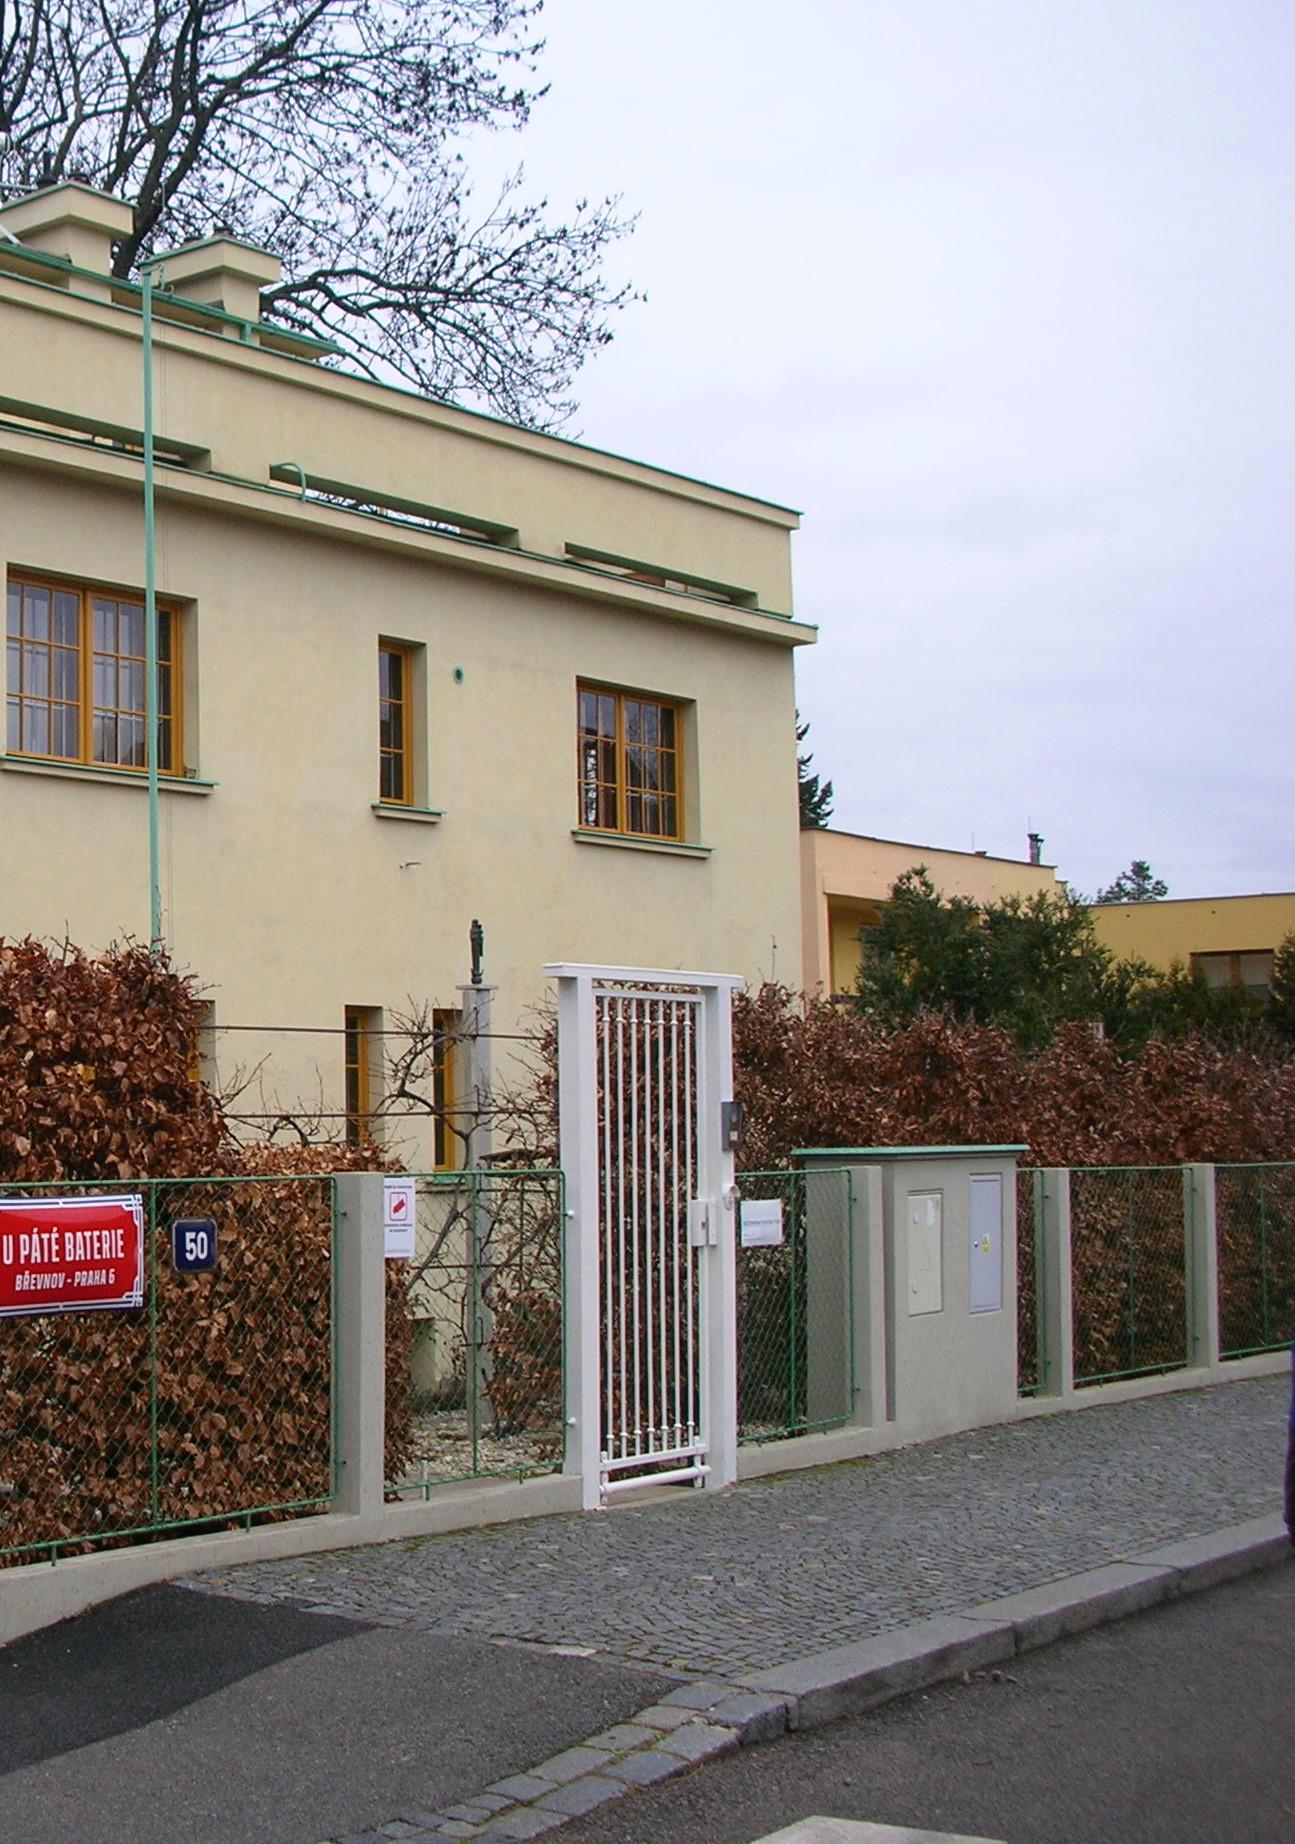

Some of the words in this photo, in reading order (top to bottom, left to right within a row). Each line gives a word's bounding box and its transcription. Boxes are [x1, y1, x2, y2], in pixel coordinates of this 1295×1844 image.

[2, 1234, 14, 1265] U
[19, 1226, 61, 1265] PÁTÉ
[64, 1228, 125, 1262] BATERIE
[185, 1231, 208, 1262] 50
[15, 1270, 66, 1292] BŘEVNOV
[73, 1269, 106, 1287] PRAHA
[108, 1268, 116, 1285] 6
